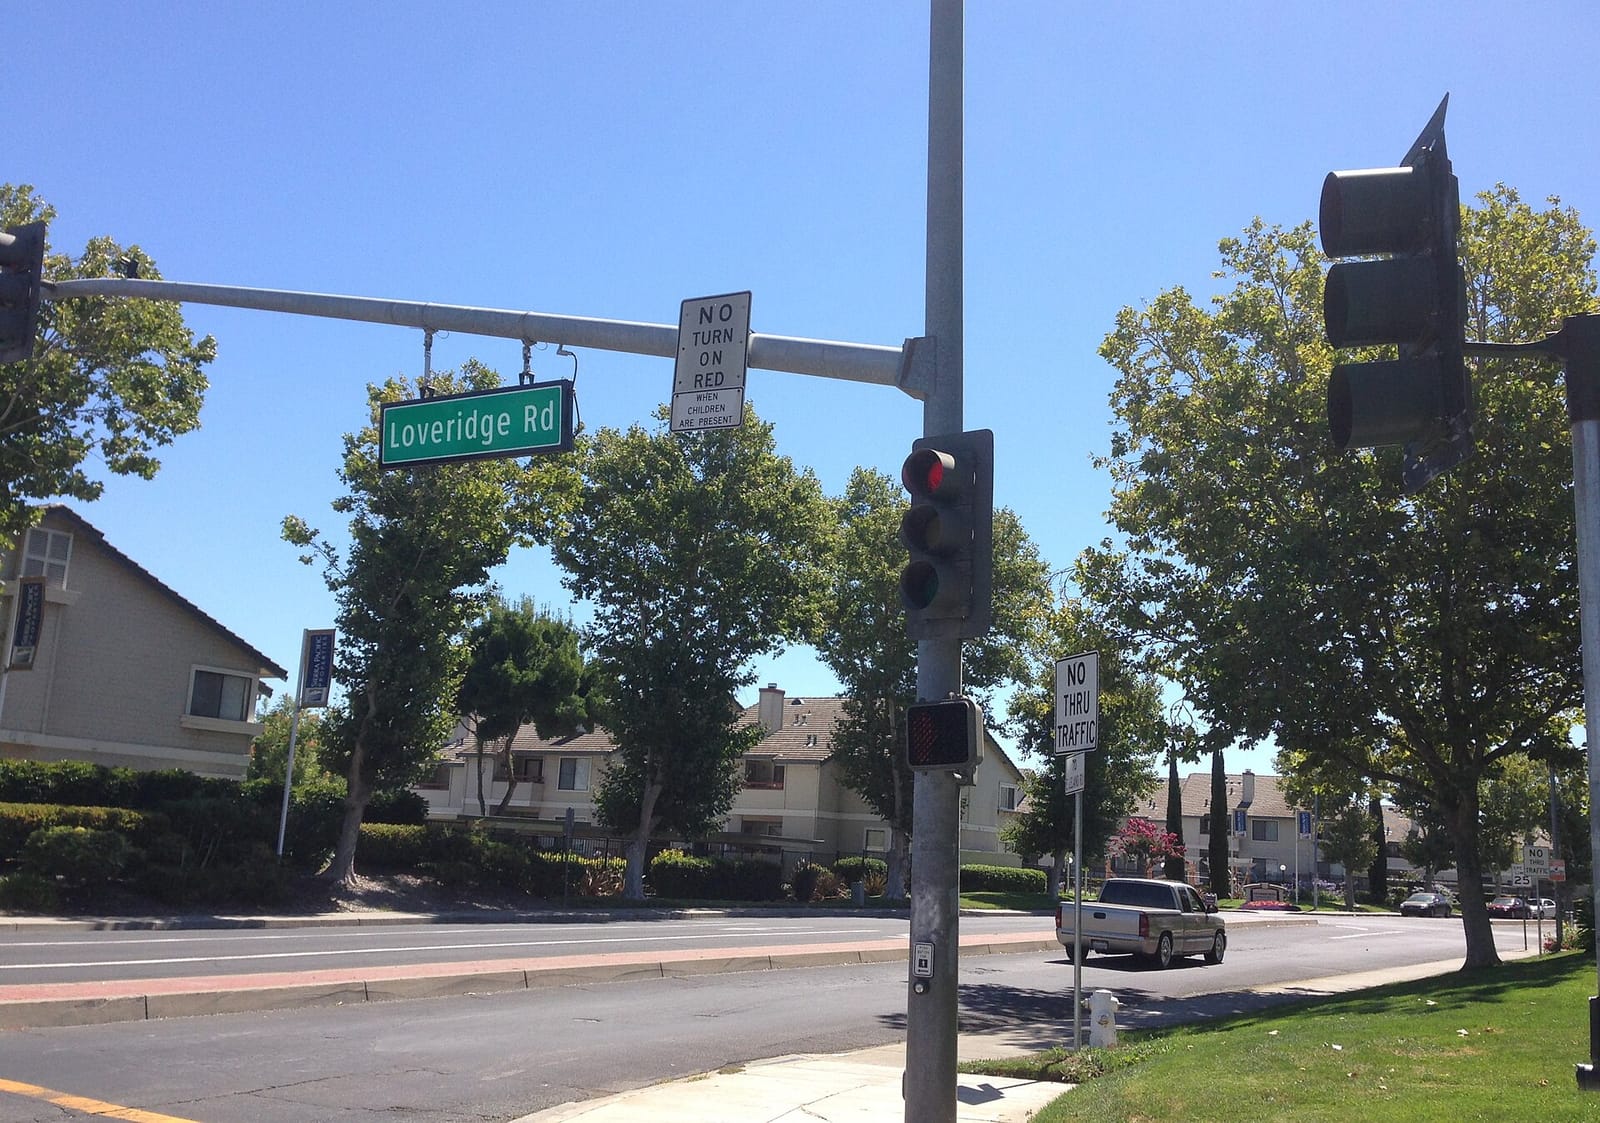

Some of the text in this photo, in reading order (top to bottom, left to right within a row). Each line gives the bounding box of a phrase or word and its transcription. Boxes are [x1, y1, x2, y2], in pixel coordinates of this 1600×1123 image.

[699, 303, 732, 325] NO
[693, 328, 734, 347] TURN
[699, 350, 722, 367] ON
[694, 371, 724, 389] RED
[696, 392, 719, 402] WHEN
[687, 404, 726, 415] CHILDREN
[390, 400, 554, 448] Loveridge Rd
[679, 415, 733, 428] ARE PRESENT
[313, 636, 322, 662] PACIFIC
[1067, 661, 1086, 687] NO
[1063, 690, 1090, 717] THRU
[1057, 720, 1096, 748] TRAFFIC
[1529, 849, 1543, 857] NO
[1514, 875, 1530, 885] 25
